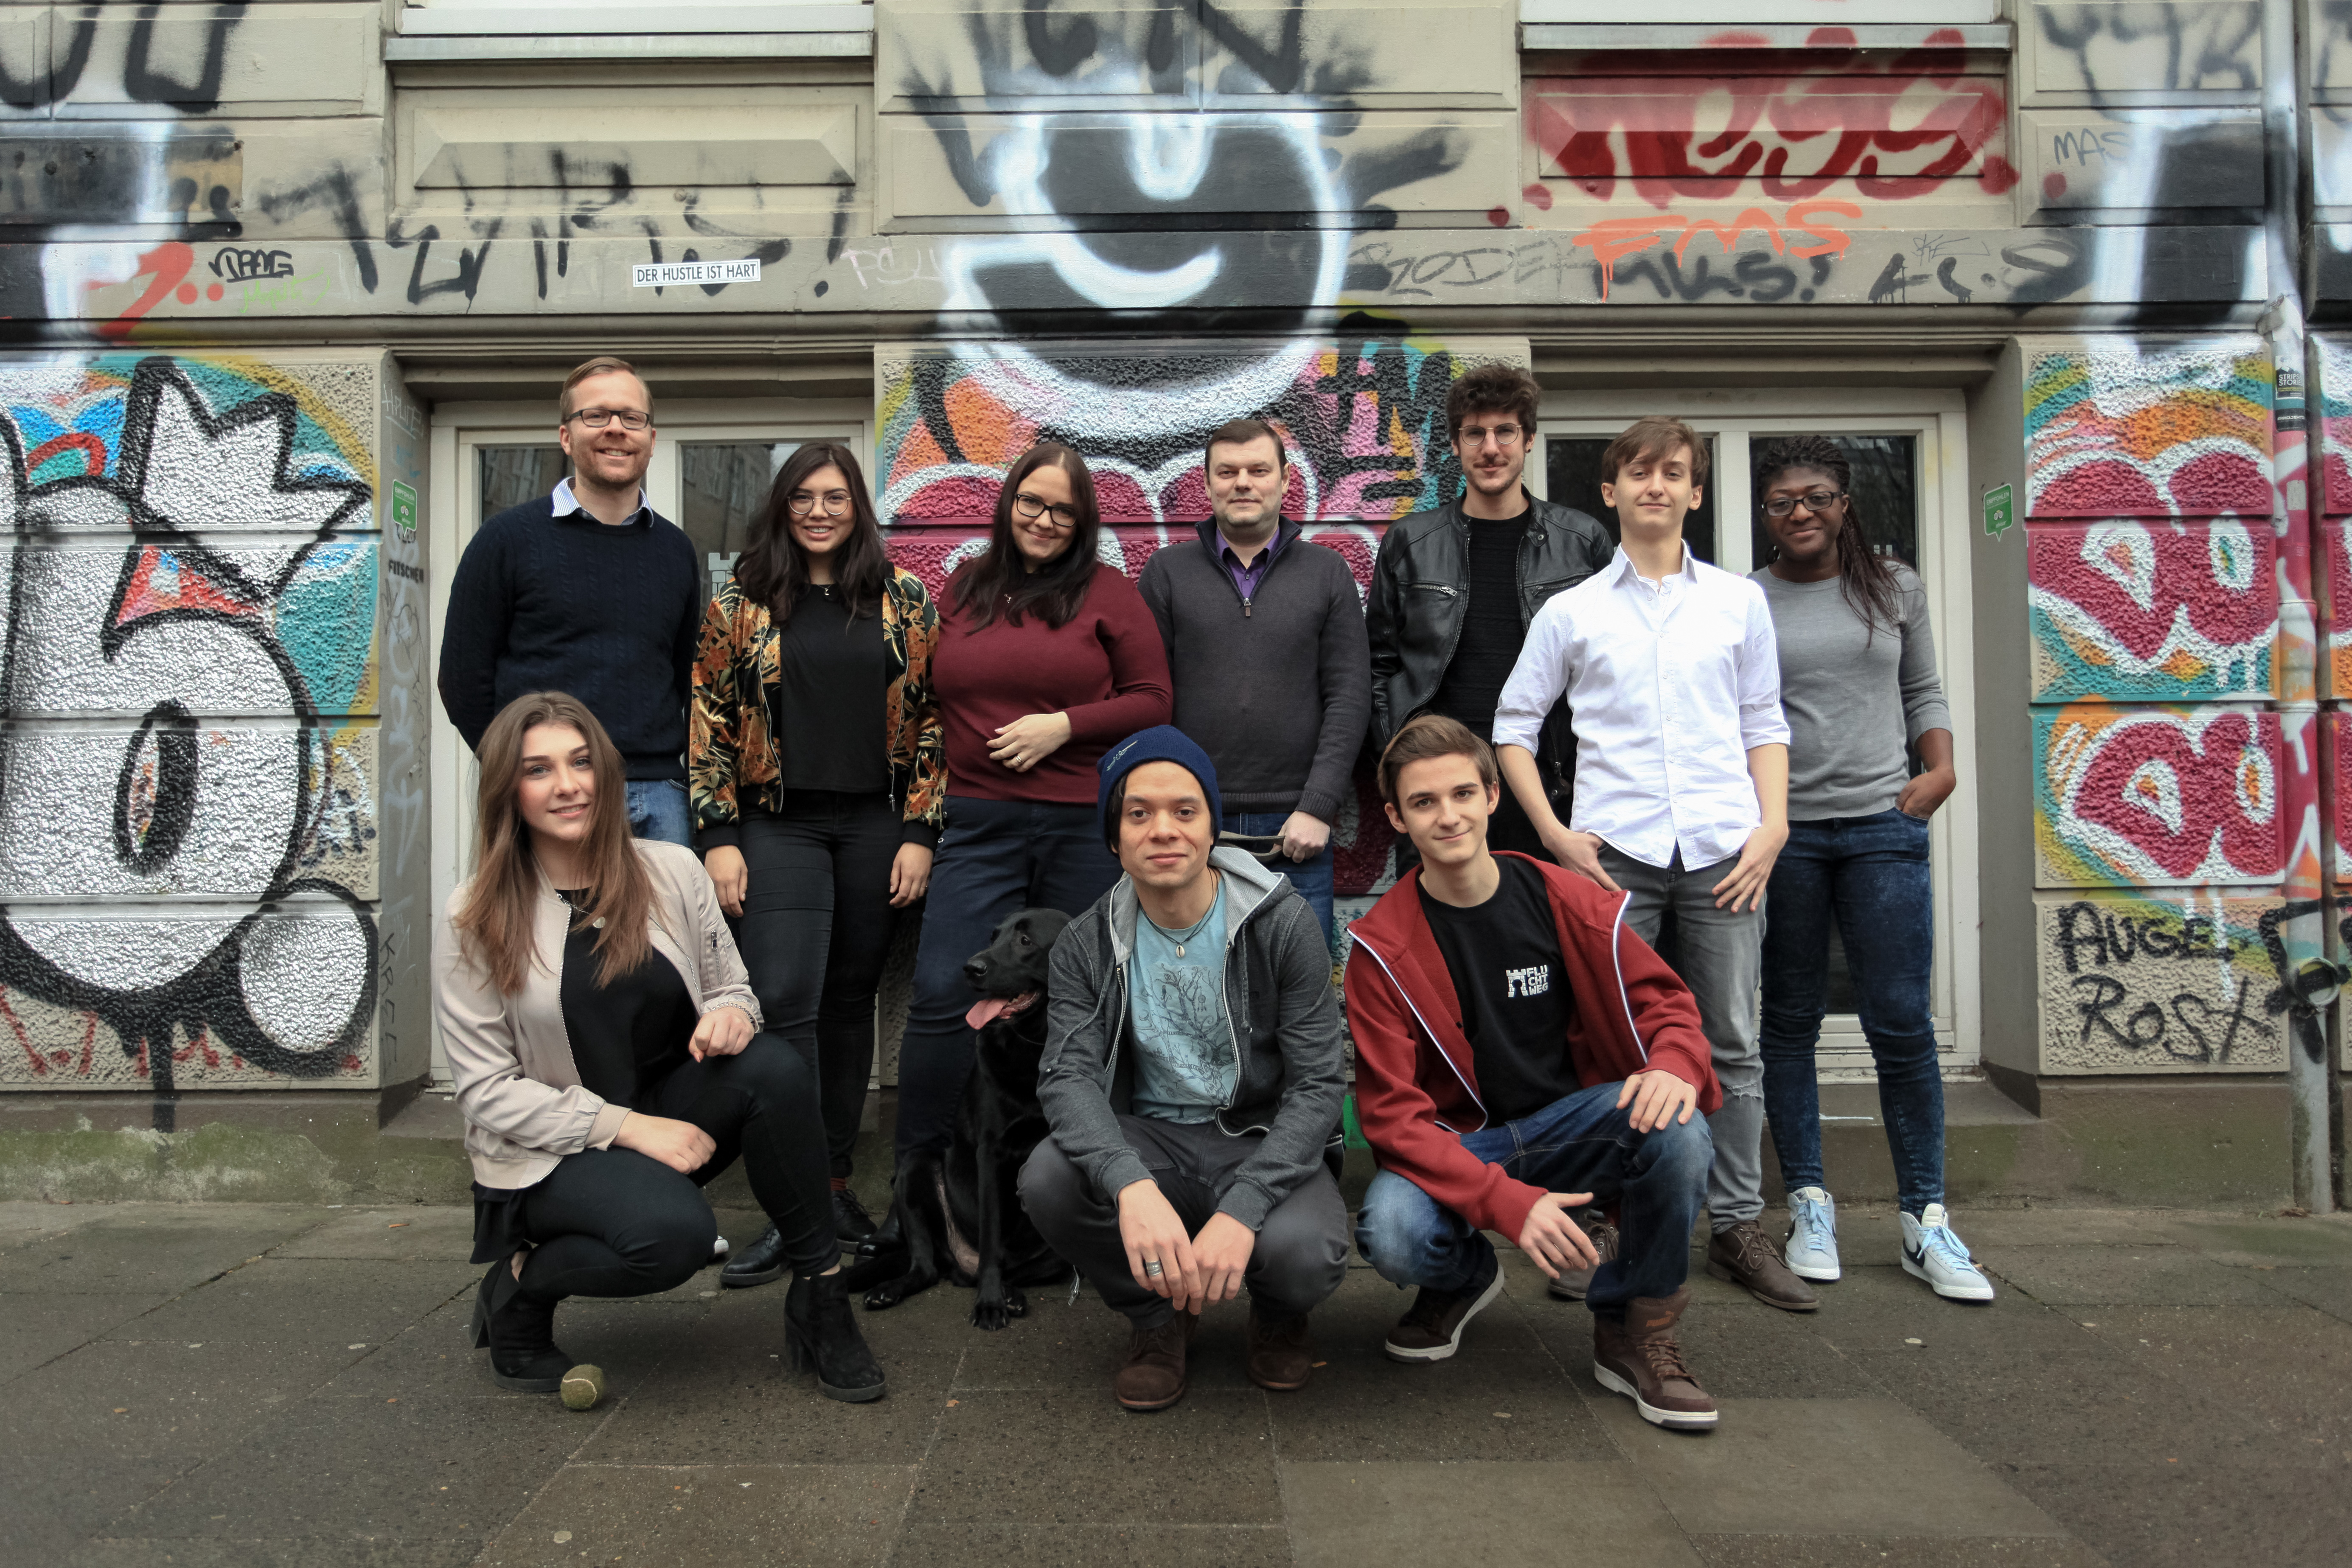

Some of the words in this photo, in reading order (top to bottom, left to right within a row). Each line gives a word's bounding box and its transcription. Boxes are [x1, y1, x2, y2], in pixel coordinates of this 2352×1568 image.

[637, 269, 658, 282] DER
[662, 266, 702, 281] HUSTLE
[707, 266, 722, 279] IST
[727, 264, 756, 278] HART
[1987, 492, 2010, 505] EMPFOHLEN
[1527, 965, 1548, 977] FLU
[1528, 974, 1548, 986] CHT
[1529, 982, 1549, 996] WEG
